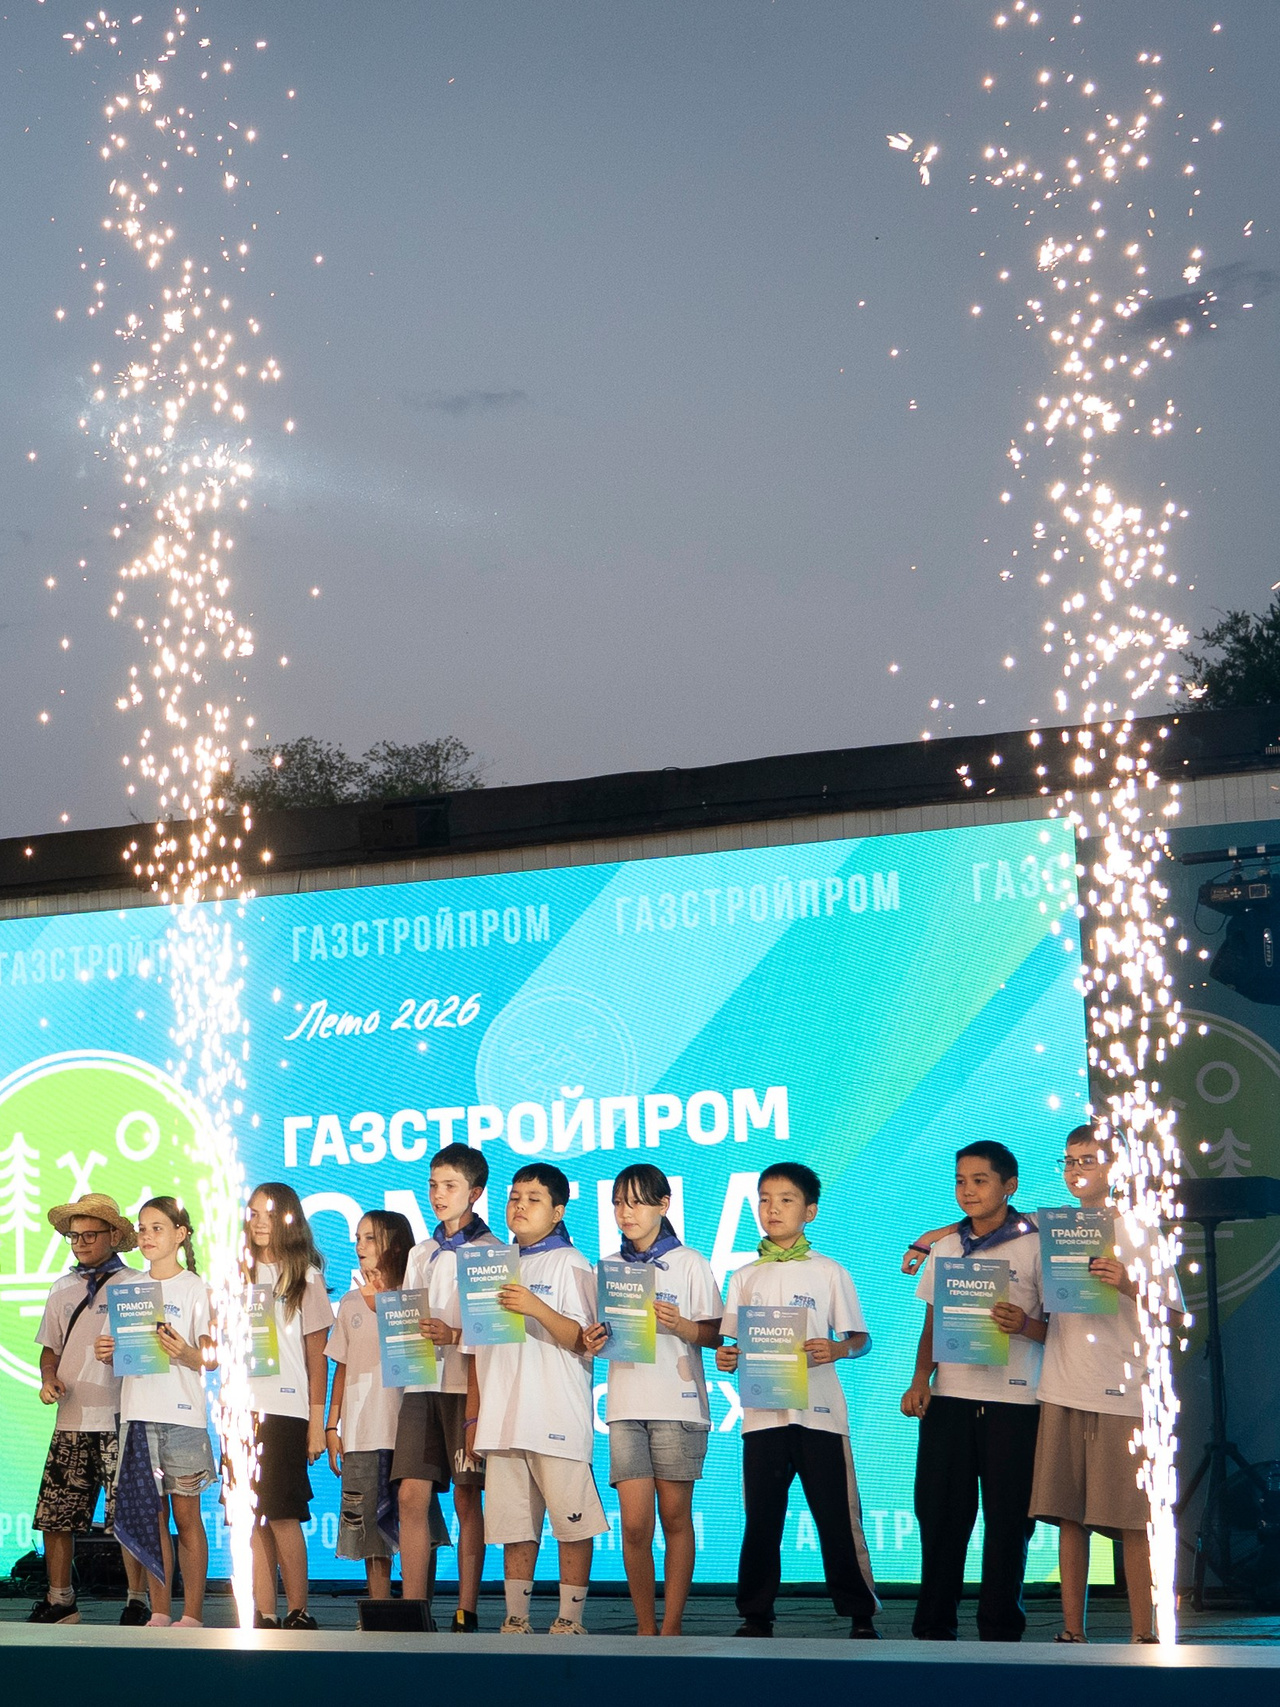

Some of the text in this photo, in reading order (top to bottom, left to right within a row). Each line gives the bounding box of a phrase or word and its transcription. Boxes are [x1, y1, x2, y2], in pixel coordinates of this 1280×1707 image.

[293, 903, 550, 963] ГАЗСТРОЙПРОМ
[614, 870, 900, 935] ГАЗСТРОЙПРОМ
[283, 993, 482, 1041] Лето 2026
[283, 1085, 789, 1168] ГАЗСТРОЙПРОМ
[1051, 1228, 1102, 1238] ГРАМОТА
[467, 1265, 509, 1276] ГРАМОТА
[606, 1281, 644, 1292] ГРАМОТА
[946, 1279, 996, 1290] ГРАМОТА
[116, 1301, 154, 1311] ГРАМОТА
[384, 1308, 420, 1320] ГРАМОТА
[748, 1326, 795, 1336] ГРАМОТА
